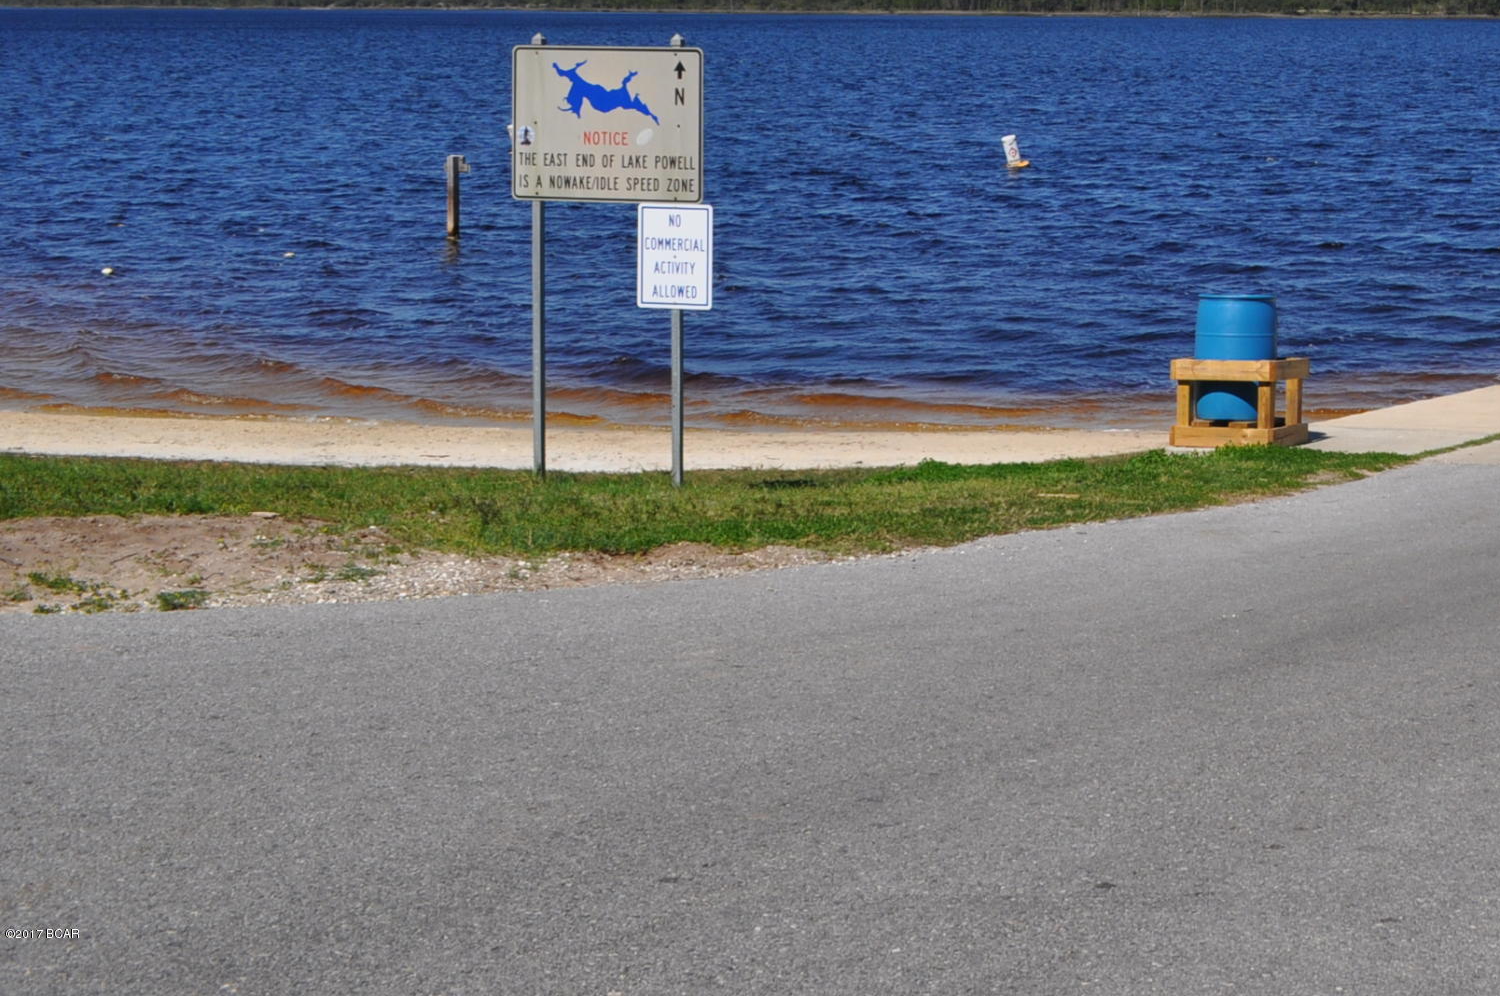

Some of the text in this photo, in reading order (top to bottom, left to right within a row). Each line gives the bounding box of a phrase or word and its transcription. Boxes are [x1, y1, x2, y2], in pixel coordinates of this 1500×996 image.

[675, 88, 685, 105] N
[583, 131, 629, 146] NOTICE
[519, 152, 696, 170] THE EAST END OF LAKE POWELL
[519, 175, 695, 193] IS A NOWAKE/IDLE SPEED ZONE
[668, 214, 682, 228] NO
[645, 237, 705, 252] COMMERCIAL
[653, 261, 696, 275] ACTIVITY
[652, 285, 697, 299] ALLOWED
